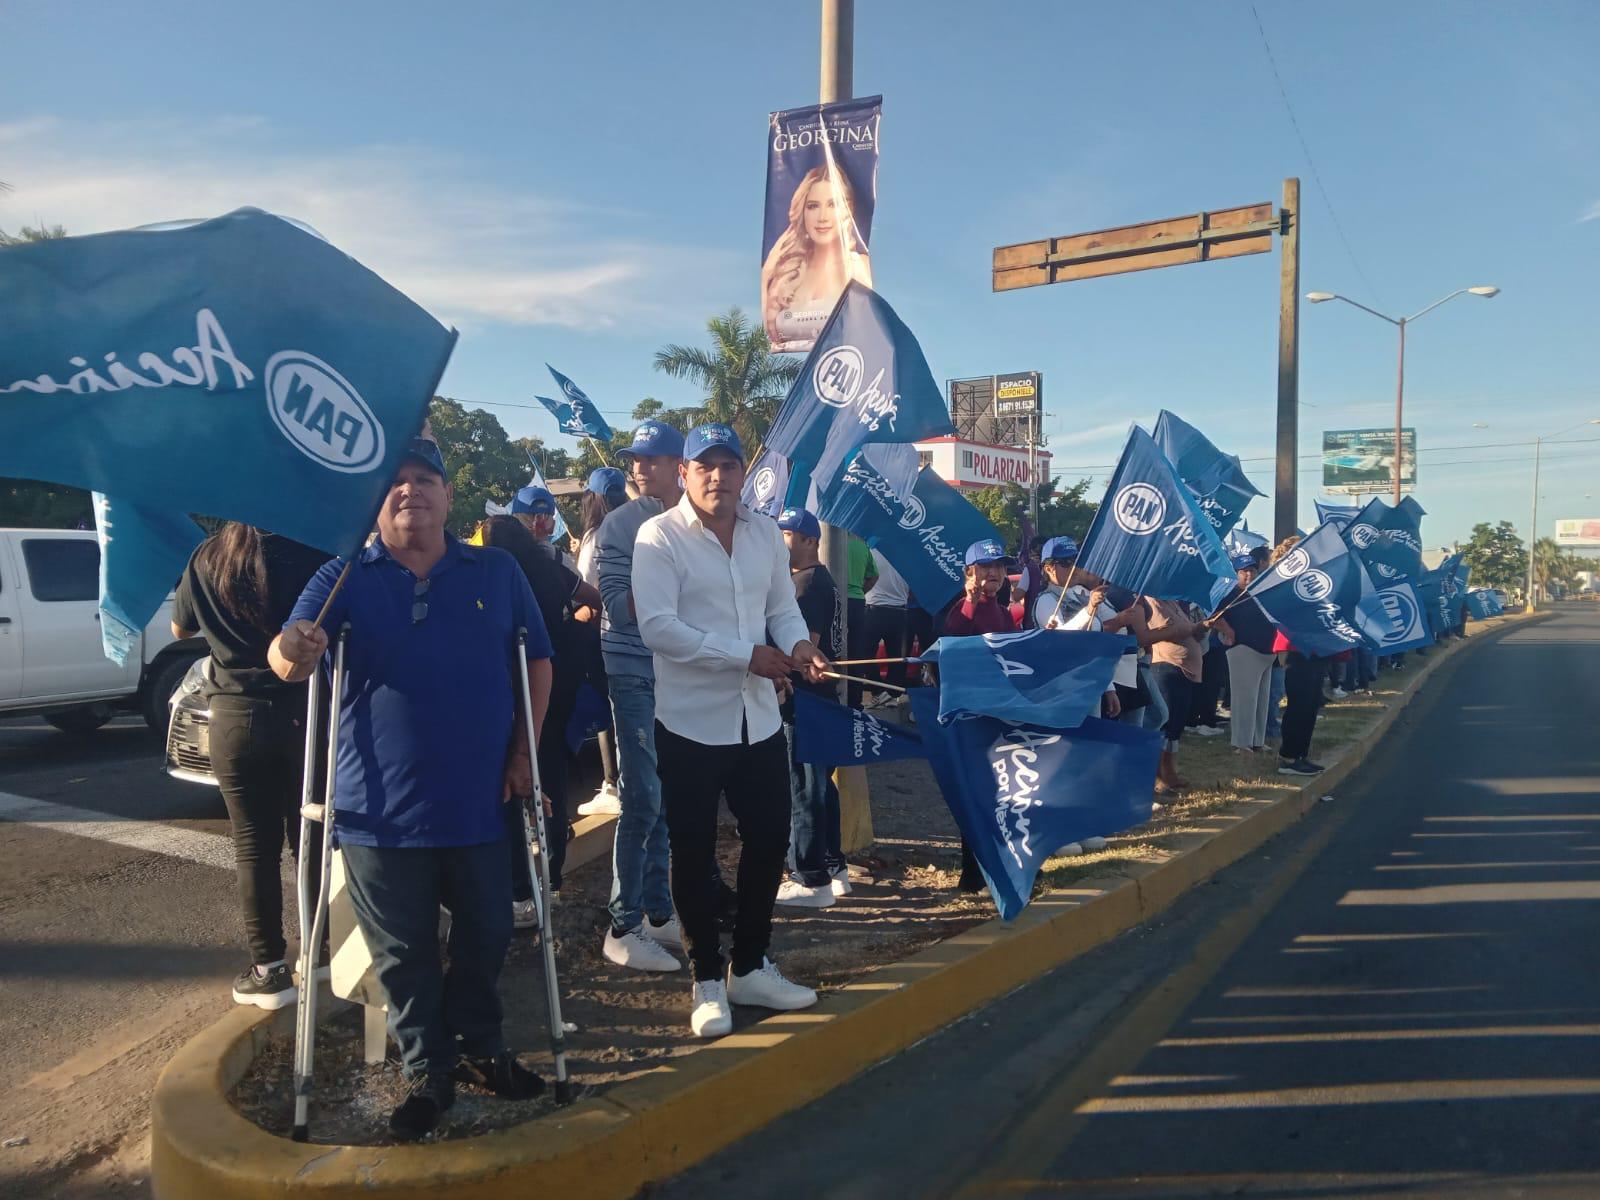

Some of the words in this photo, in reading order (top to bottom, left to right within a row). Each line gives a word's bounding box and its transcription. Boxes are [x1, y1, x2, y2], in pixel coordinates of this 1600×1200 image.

[773, 124, 873, 152] GEORGINA
[822, 357, 858, 396] PAN
[1000, 380, 1032, 389] ESPACIO
[1001, 387, 1032, 398] DISPONIBLE
[973, 453, 1040, 485] POLARIZADS
[1122, 492, 1161, 526] PAN
[1300, 574, 1326, 596] PAN
[992, 758, 1010, 793] por
[994, 728, 1063, 857] Acción
